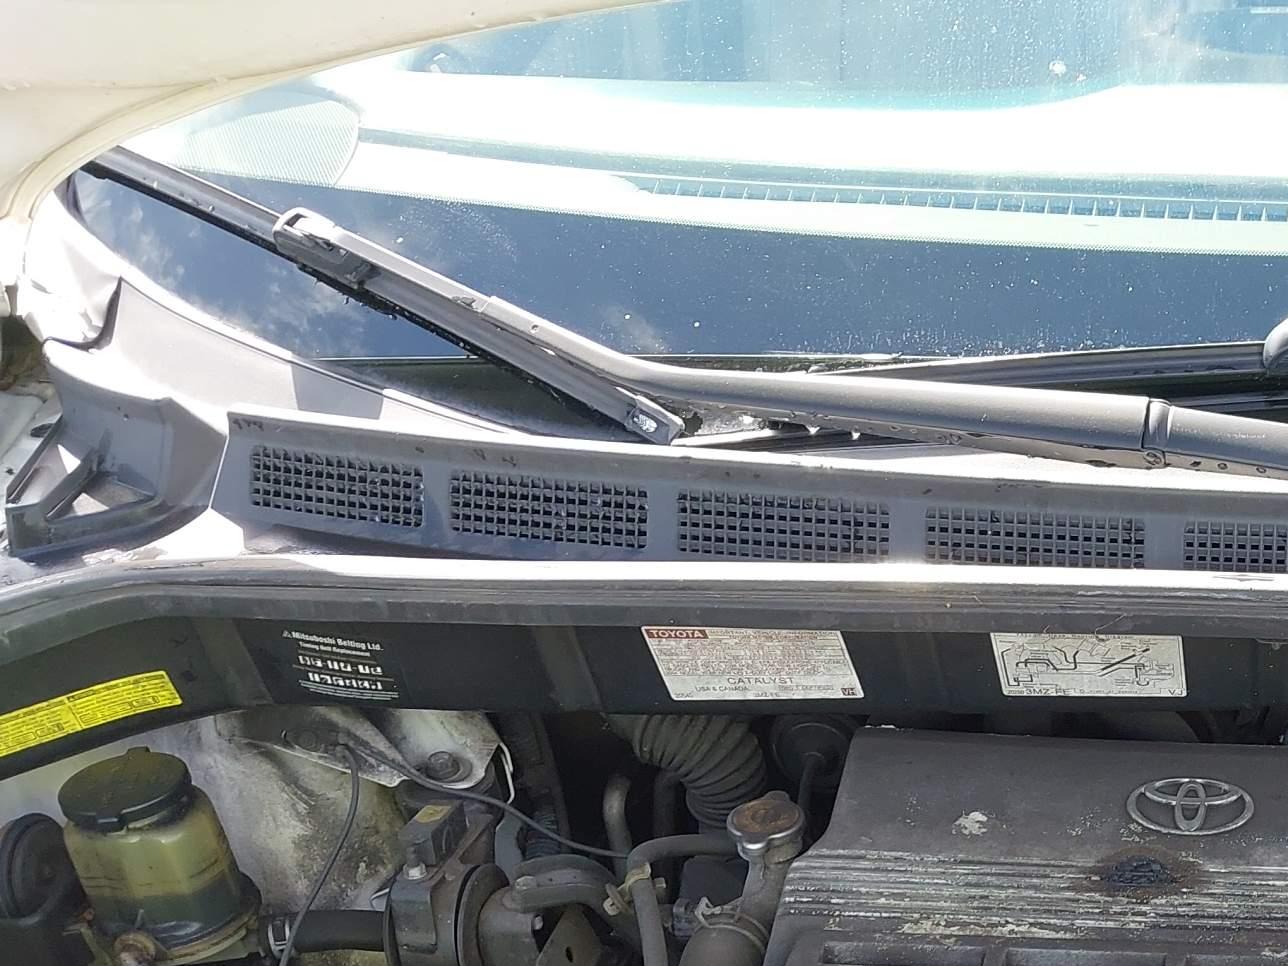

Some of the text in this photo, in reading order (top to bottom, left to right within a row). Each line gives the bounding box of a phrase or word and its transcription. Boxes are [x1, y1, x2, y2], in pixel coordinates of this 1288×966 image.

[650, 630, 704, 638] TOYOTA
[336, 638, 366, 650] Belting
[367, 642, 384, 651] Ltd.
[727, 677, 794, 685] CATALYST
